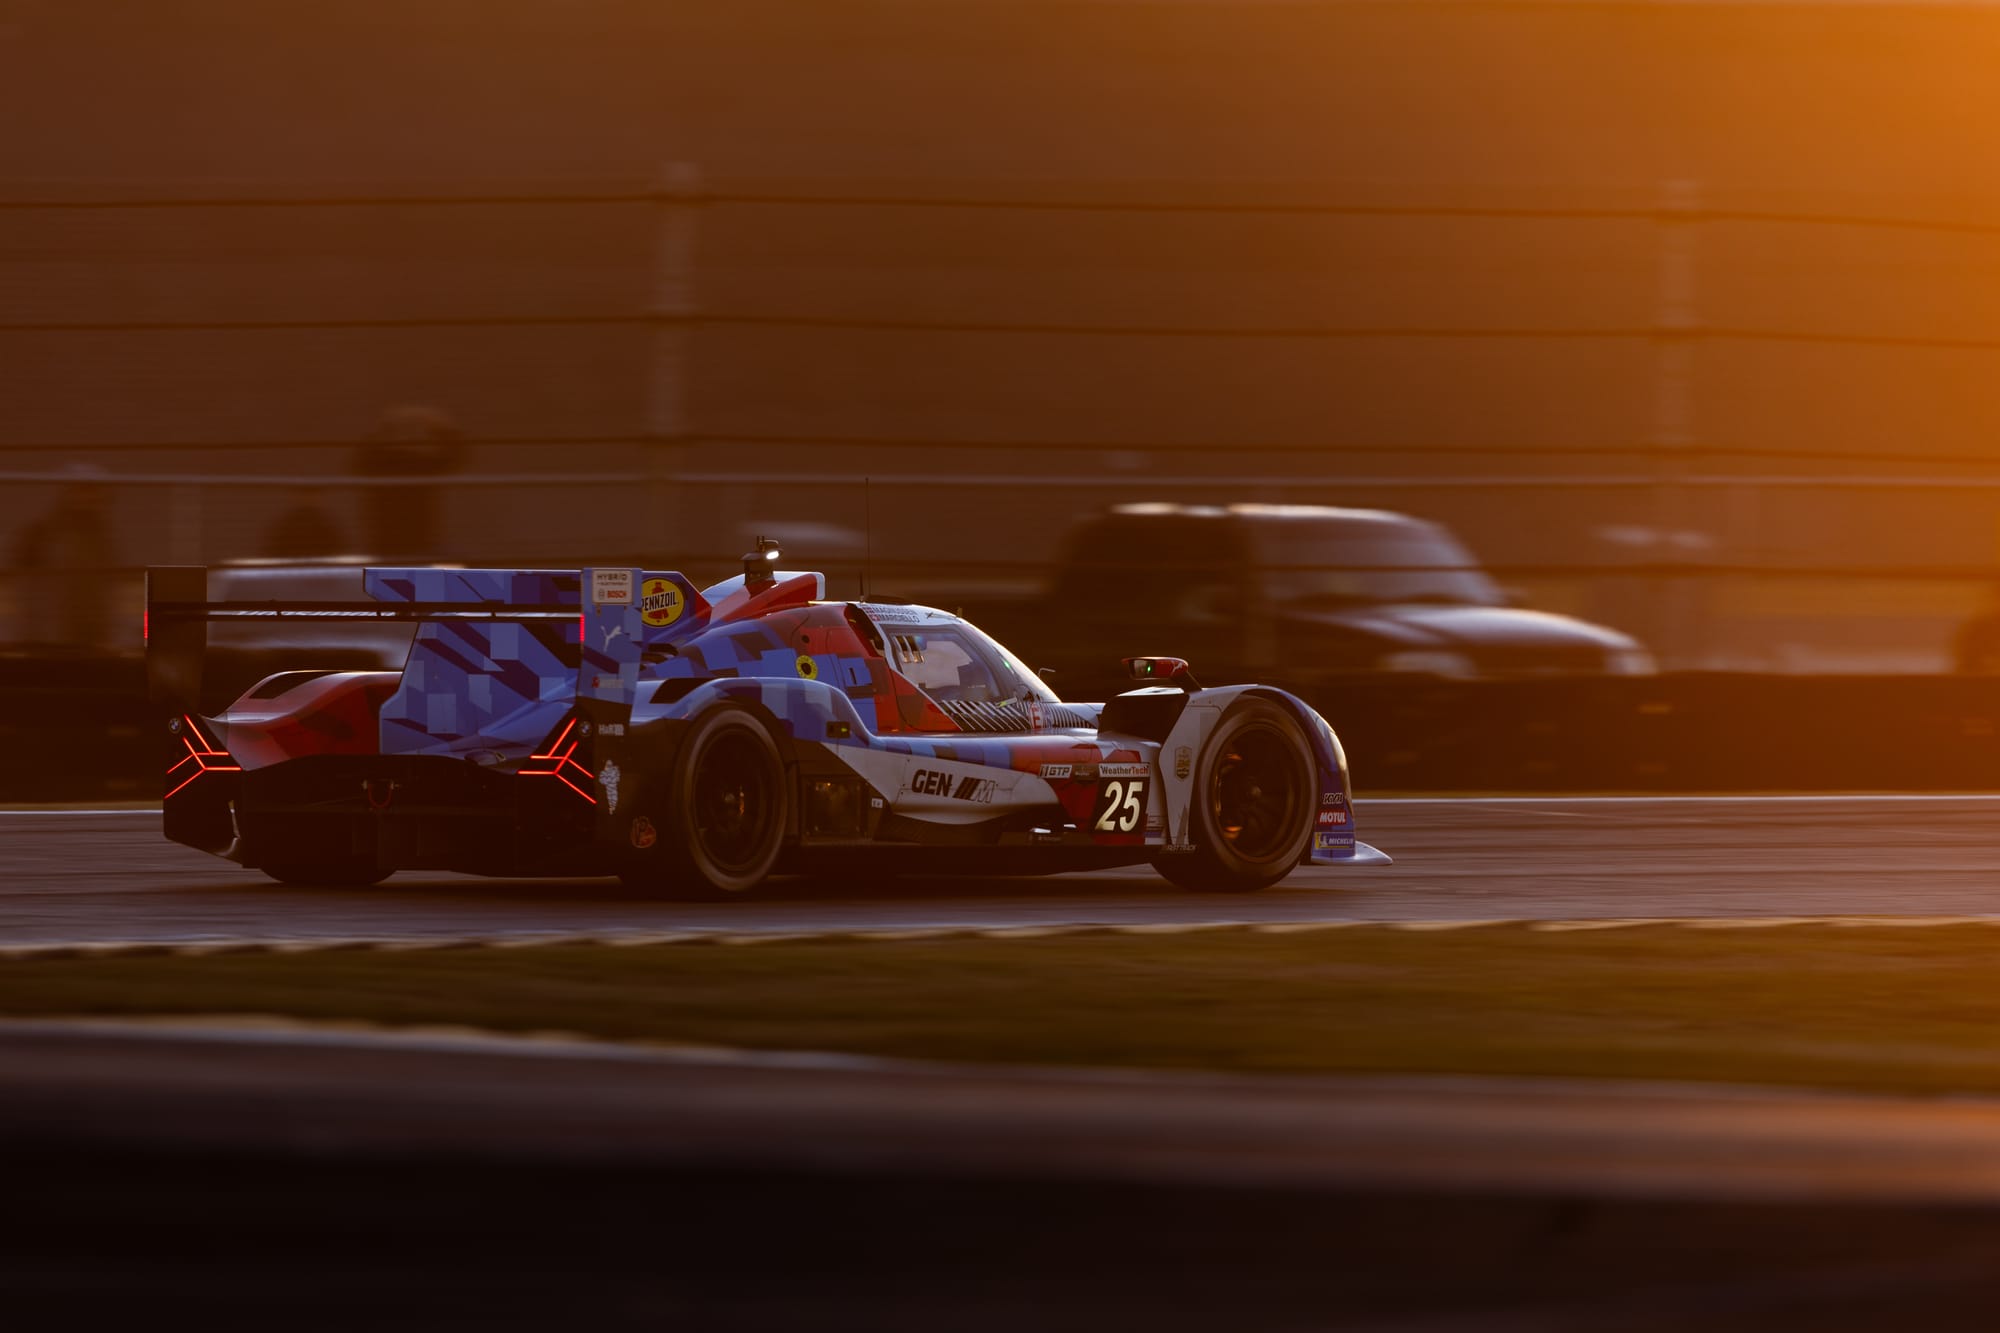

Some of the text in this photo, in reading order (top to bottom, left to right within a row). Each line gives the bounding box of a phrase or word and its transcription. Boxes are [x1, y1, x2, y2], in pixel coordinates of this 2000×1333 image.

[1048, 766, 1070, 776] GTP
[1100, 764, 1149, 775] WeatherTech
[911, 769, 954, 798] GEN
[1095, 781, 1144, 832] 25
[1319, 811, 1346, 823] MOTUL
